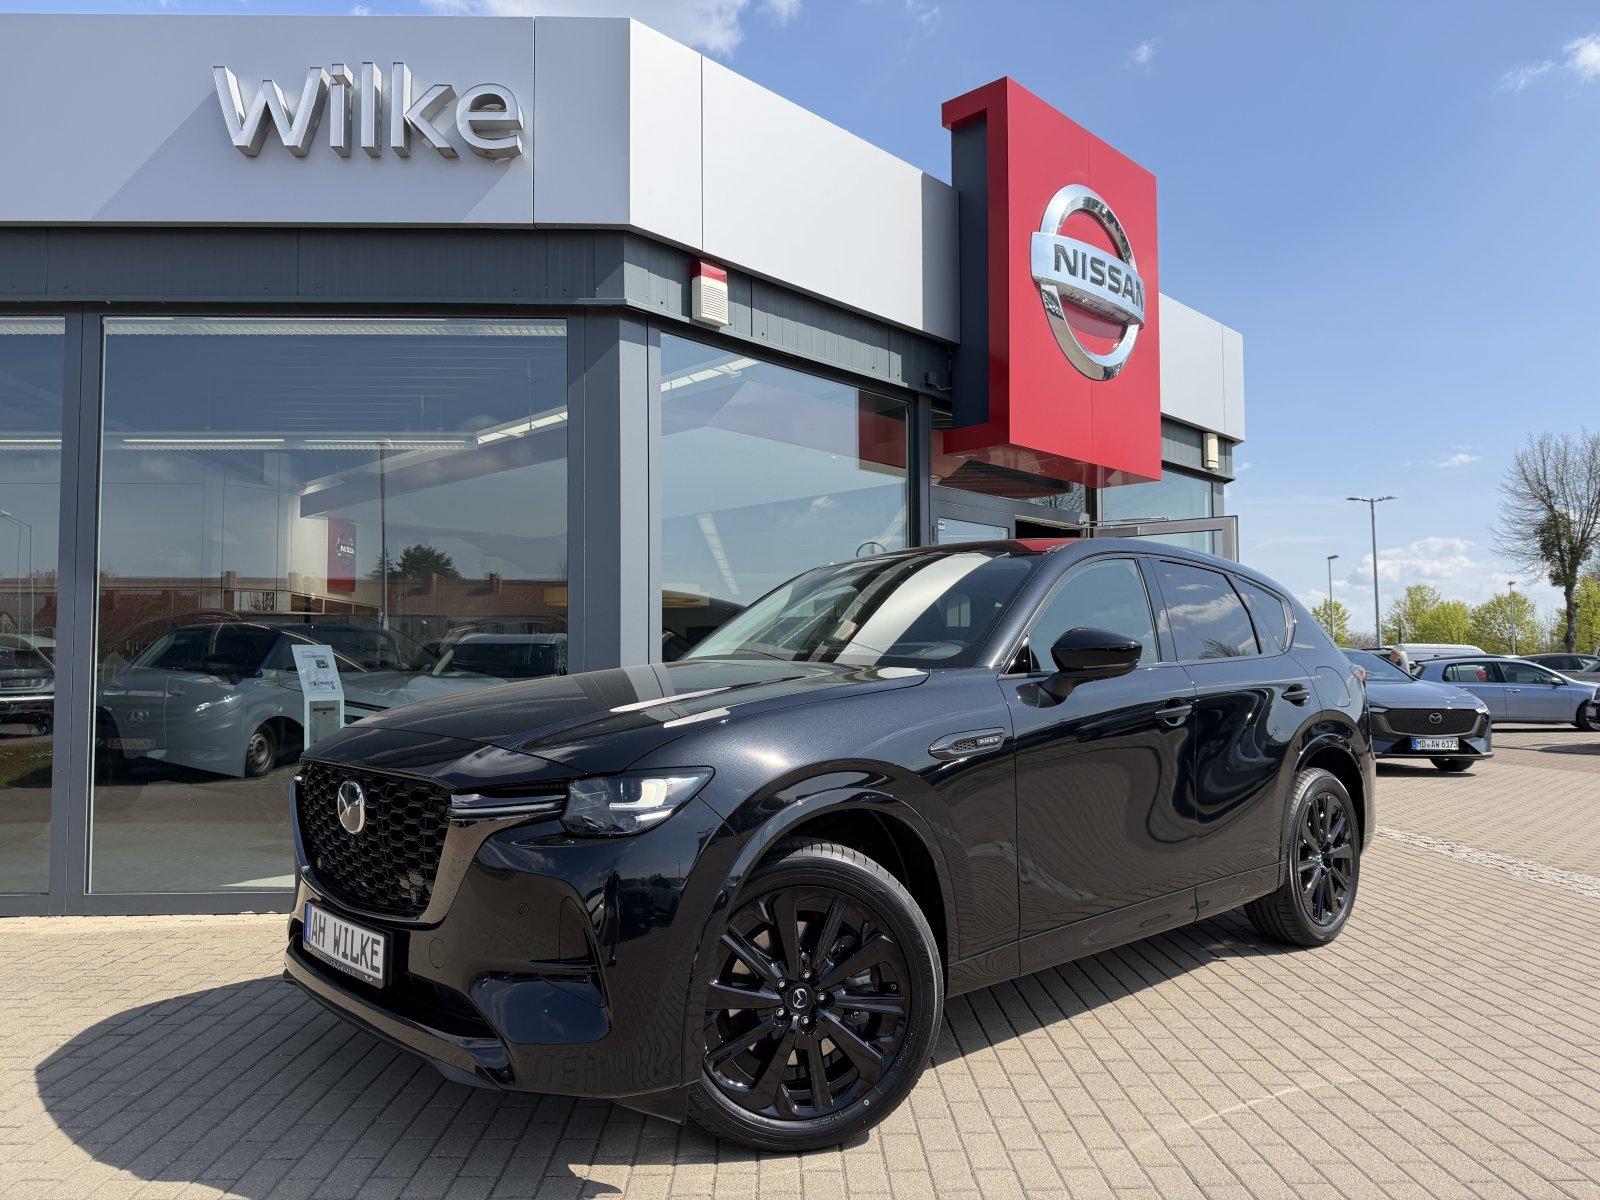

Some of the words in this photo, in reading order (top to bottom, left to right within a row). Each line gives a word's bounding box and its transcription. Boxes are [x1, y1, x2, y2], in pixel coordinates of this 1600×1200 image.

[213, 61, 523, 159] Wilke
[312, 911, 327, 949] AH
[333, 921, 381, 974] WILKE
